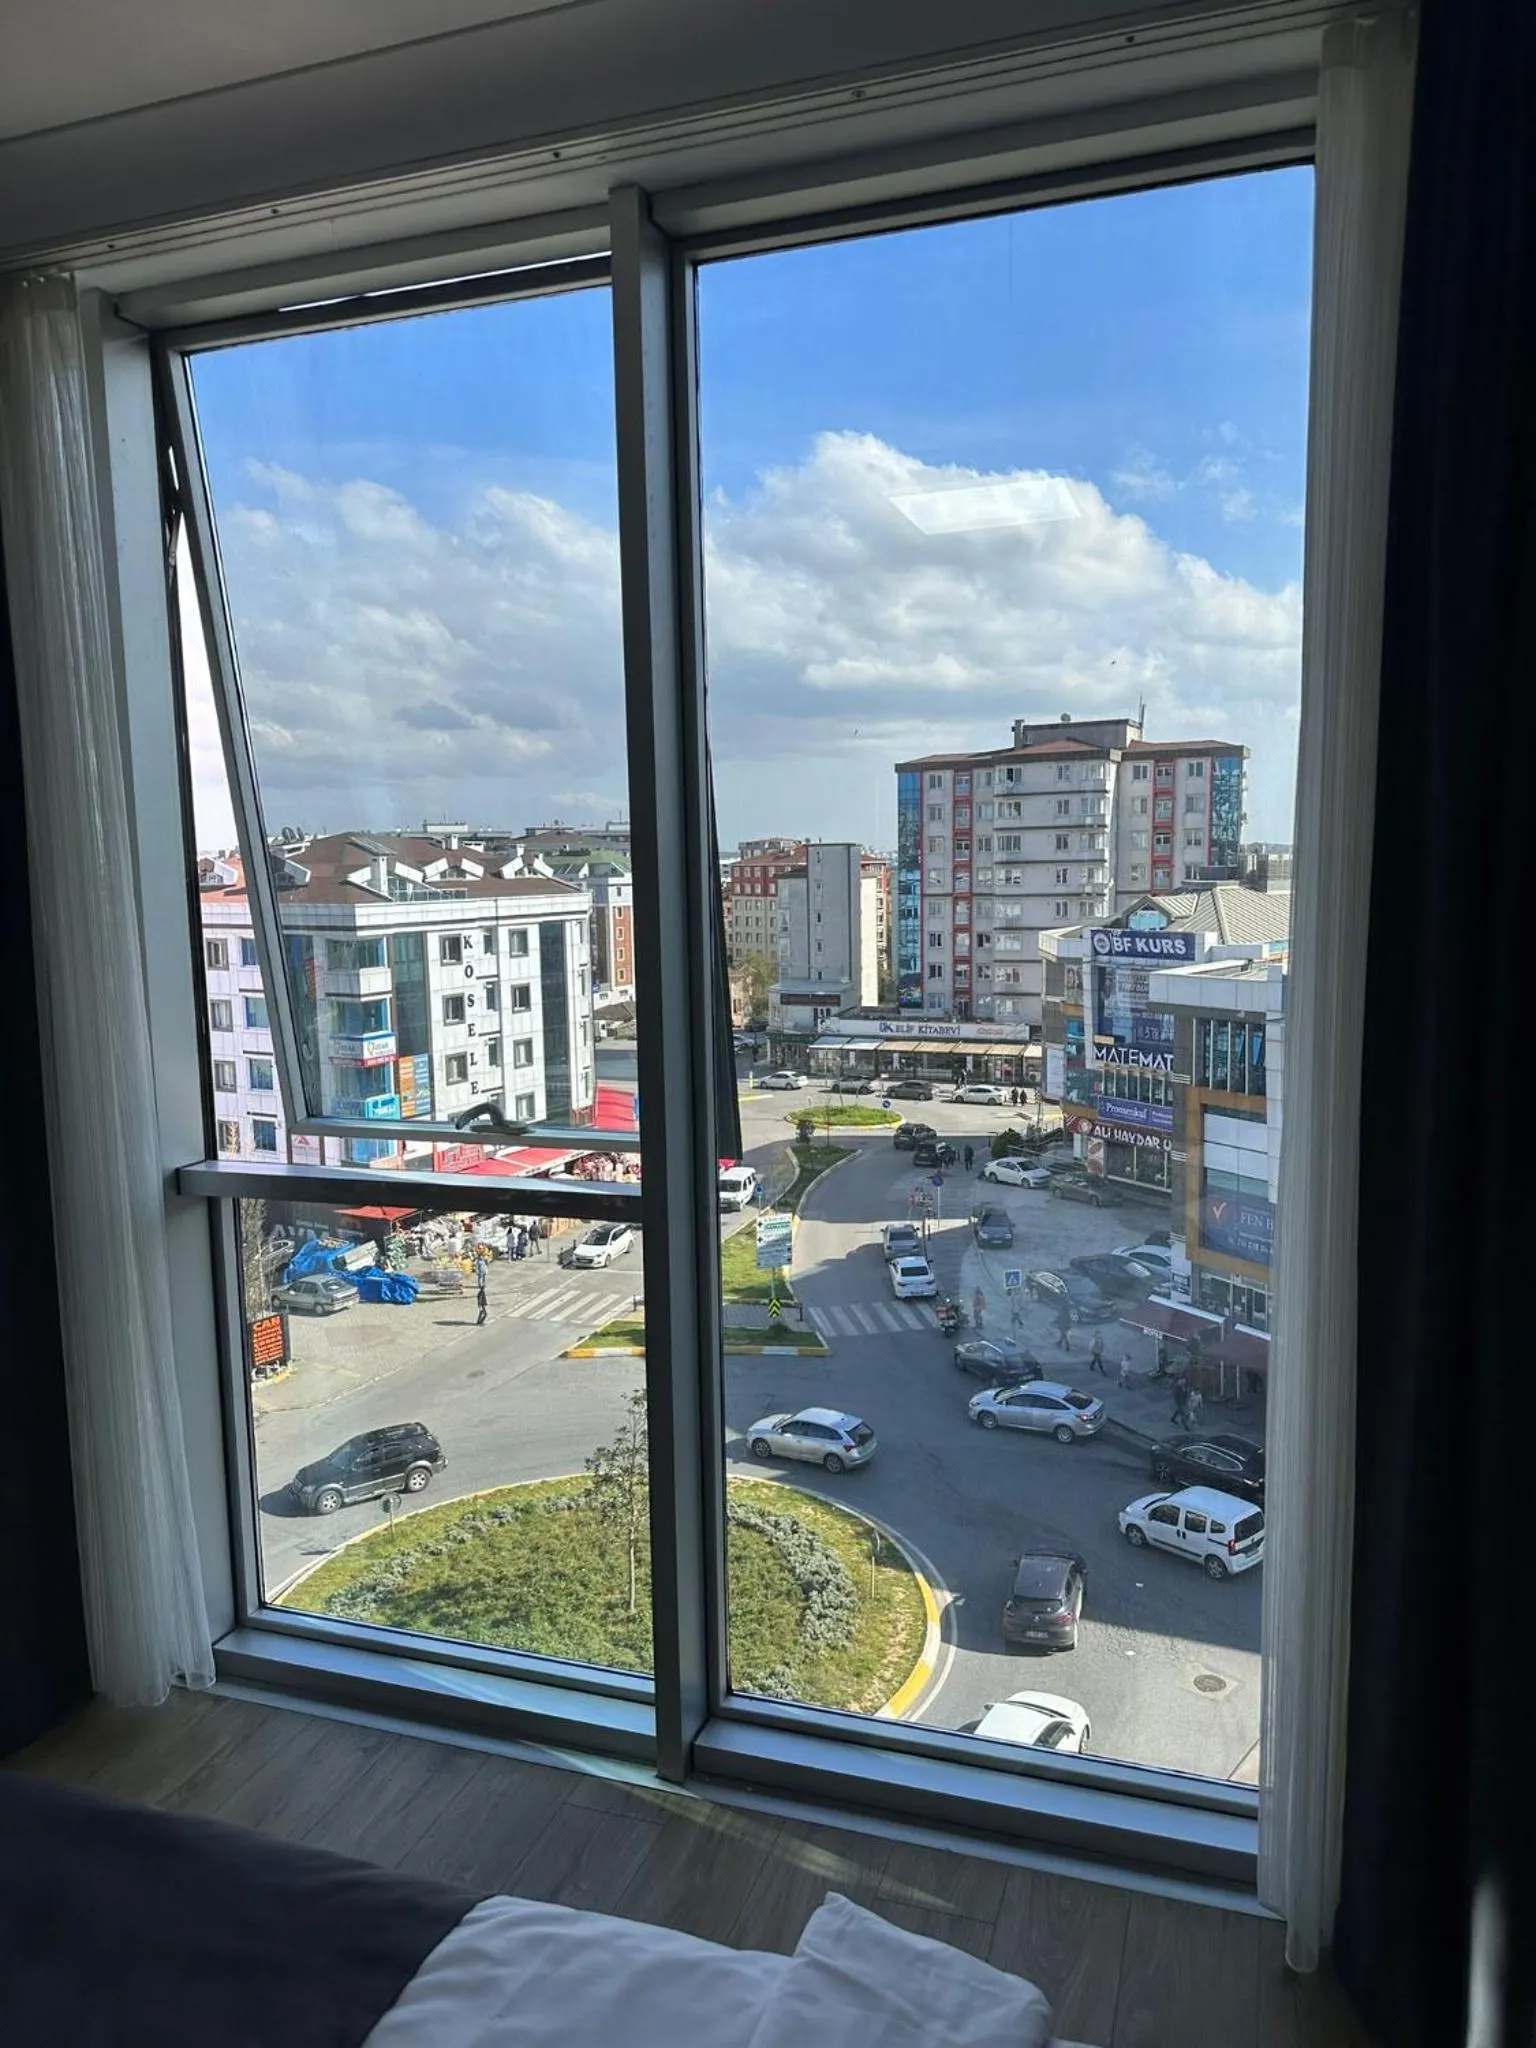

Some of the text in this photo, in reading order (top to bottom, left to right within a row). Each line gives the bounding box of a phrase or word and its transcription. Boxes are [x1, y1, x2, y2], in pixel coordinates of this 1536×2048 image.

[1135, 938, 1186, 955] KURS
[463, 935, 480, 1095] KÖSELE
[1093, 1045, 1175, 1071] MATEMAT
[1114, 1128, 1160, 1149] HAYDAR
